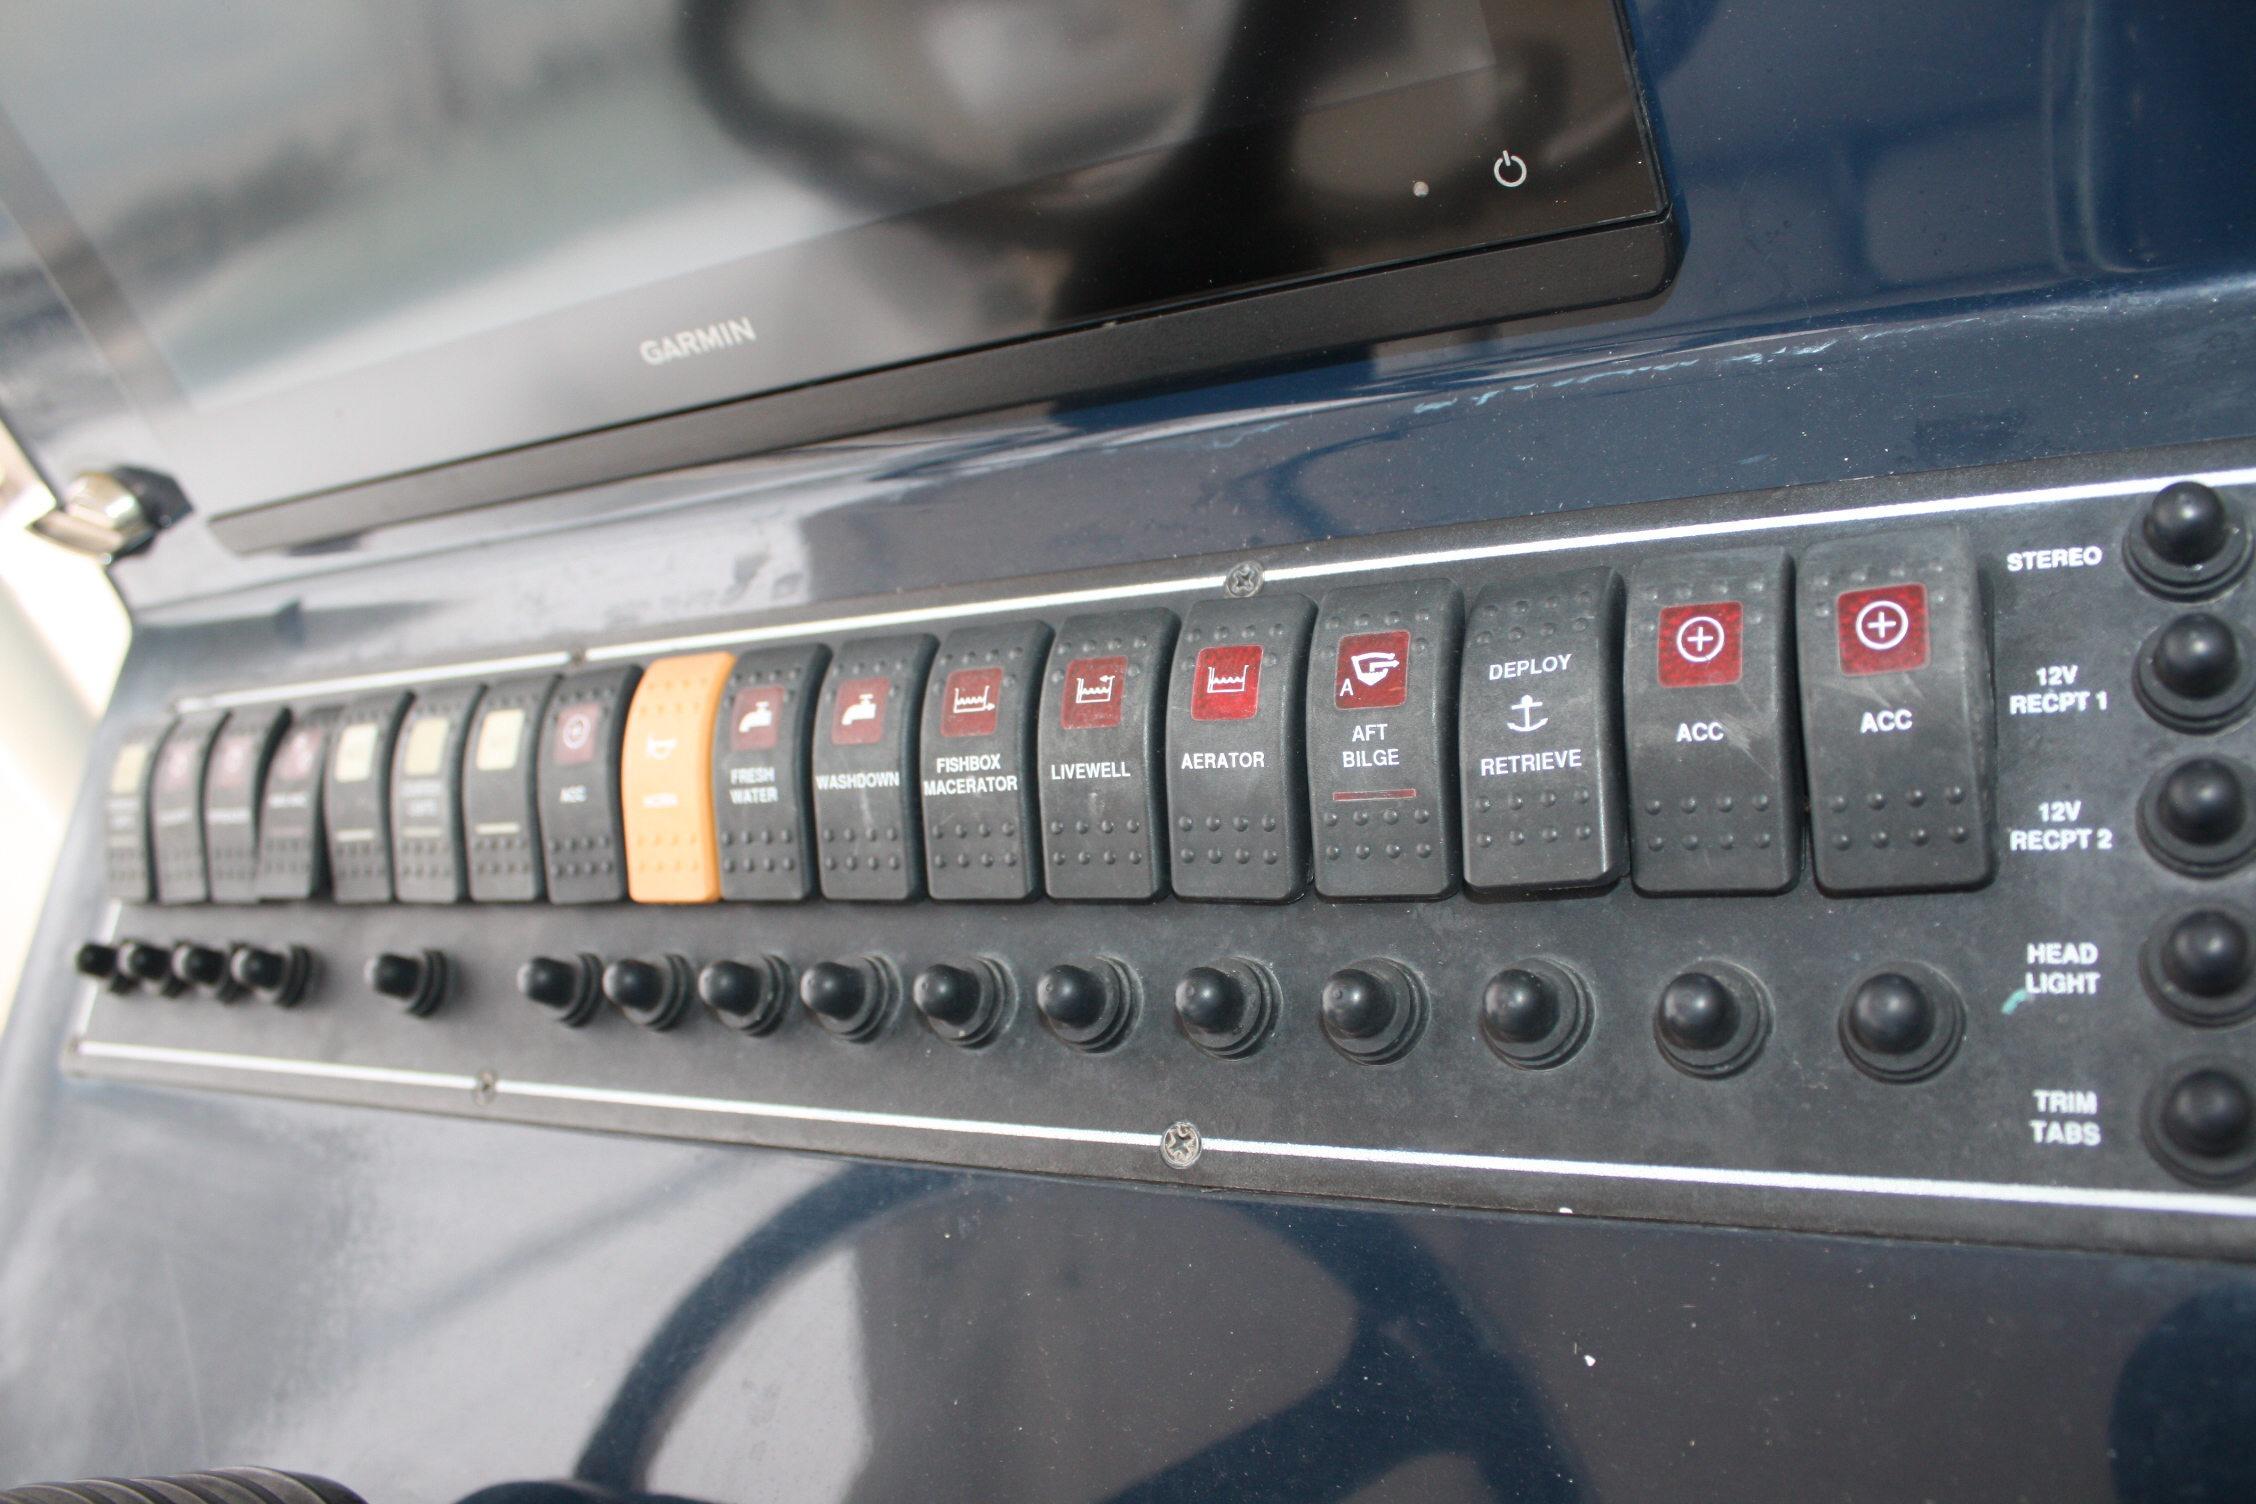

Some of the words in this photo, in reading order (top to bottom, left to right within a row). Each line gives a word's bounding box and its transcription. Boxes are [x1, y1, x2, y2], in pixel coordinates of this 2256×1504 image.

[639, 317, 756, 365] GARMIN
[2007, 546, 2104, 572] STEREO
[1488, 653, 1572, 681] DEPLOY
[2036, 666, 2079, 687] 12V
[2009, 691, 2091, 714] RECPT
[2097, 691, 2108, 711] 1
[1860, 709, 1913, 734] ACC
[1352, 724, 1388, 742] AFT
[1676, 723, 1724, 743] ACC
[936, 754, 1001, 774] FISHBOX
[1181, 751, 1265, 770] AERATOR
[1342, 749, 1400, 768] BILGE
[1480, 748, 1583, 777] RETRIEVE
[731, 768, 775, 785] FRESH
[816, 771, 900, 790] WASHDOWN
[1051, 761, 1131, 781] LIVEWELL
[730, 786, 778, 804] WATER
[923, 775, 1019, 797] MACERATOR
[2038, 801, 2082, 823] 12V
[2010, 829, 2092, 852] RECPT
[2097, 828, 2113, 850] 2
[2027, 943, 2099, 966] HEAD
[2026, 972, 2100, 996] LIGHT
[2033, 1090, 2098, 1115] TRIM
[2030, 1119, 2102, 1147] TABS
